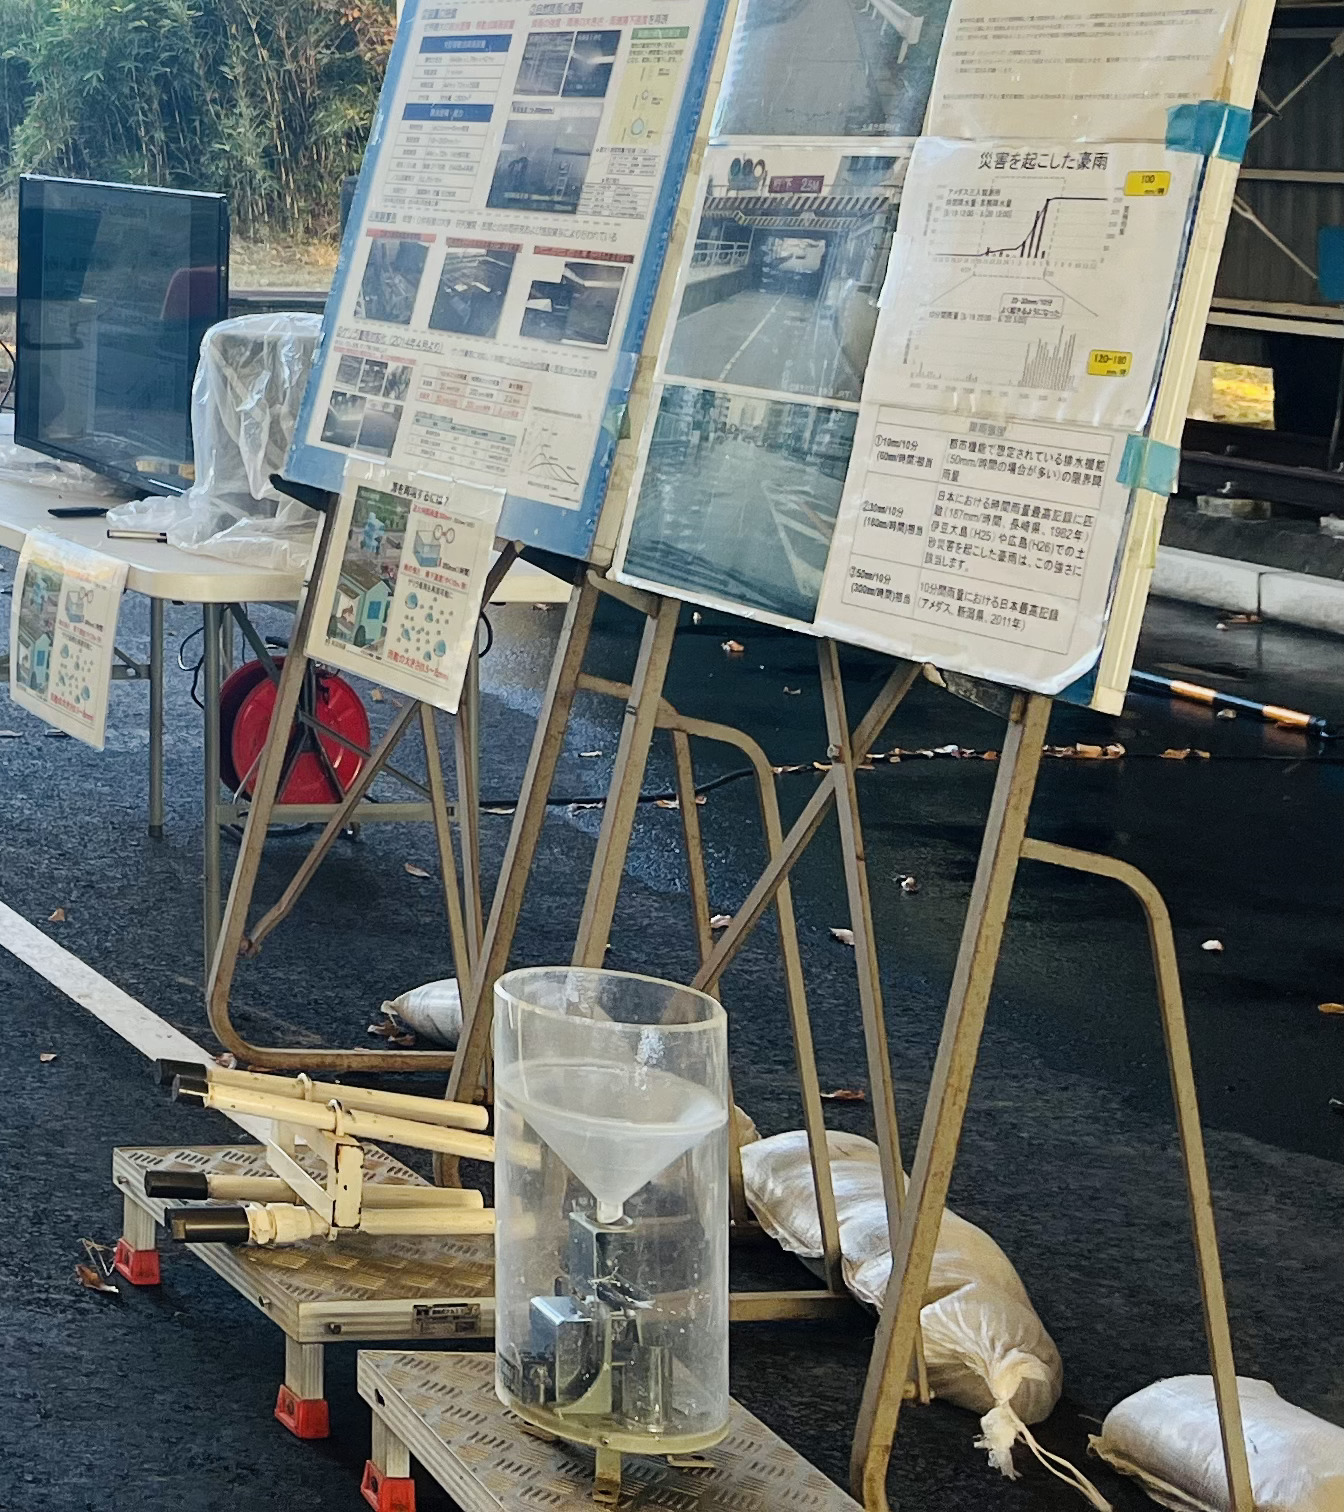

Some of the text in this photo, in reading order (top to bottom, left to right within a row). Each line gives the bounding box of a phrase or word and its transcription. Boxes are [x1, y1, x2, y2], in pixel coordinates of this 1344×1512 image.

[978, 151, 1110, 171] 災害を起こした豪雨
[1141, 174, 1156, 184] 100
